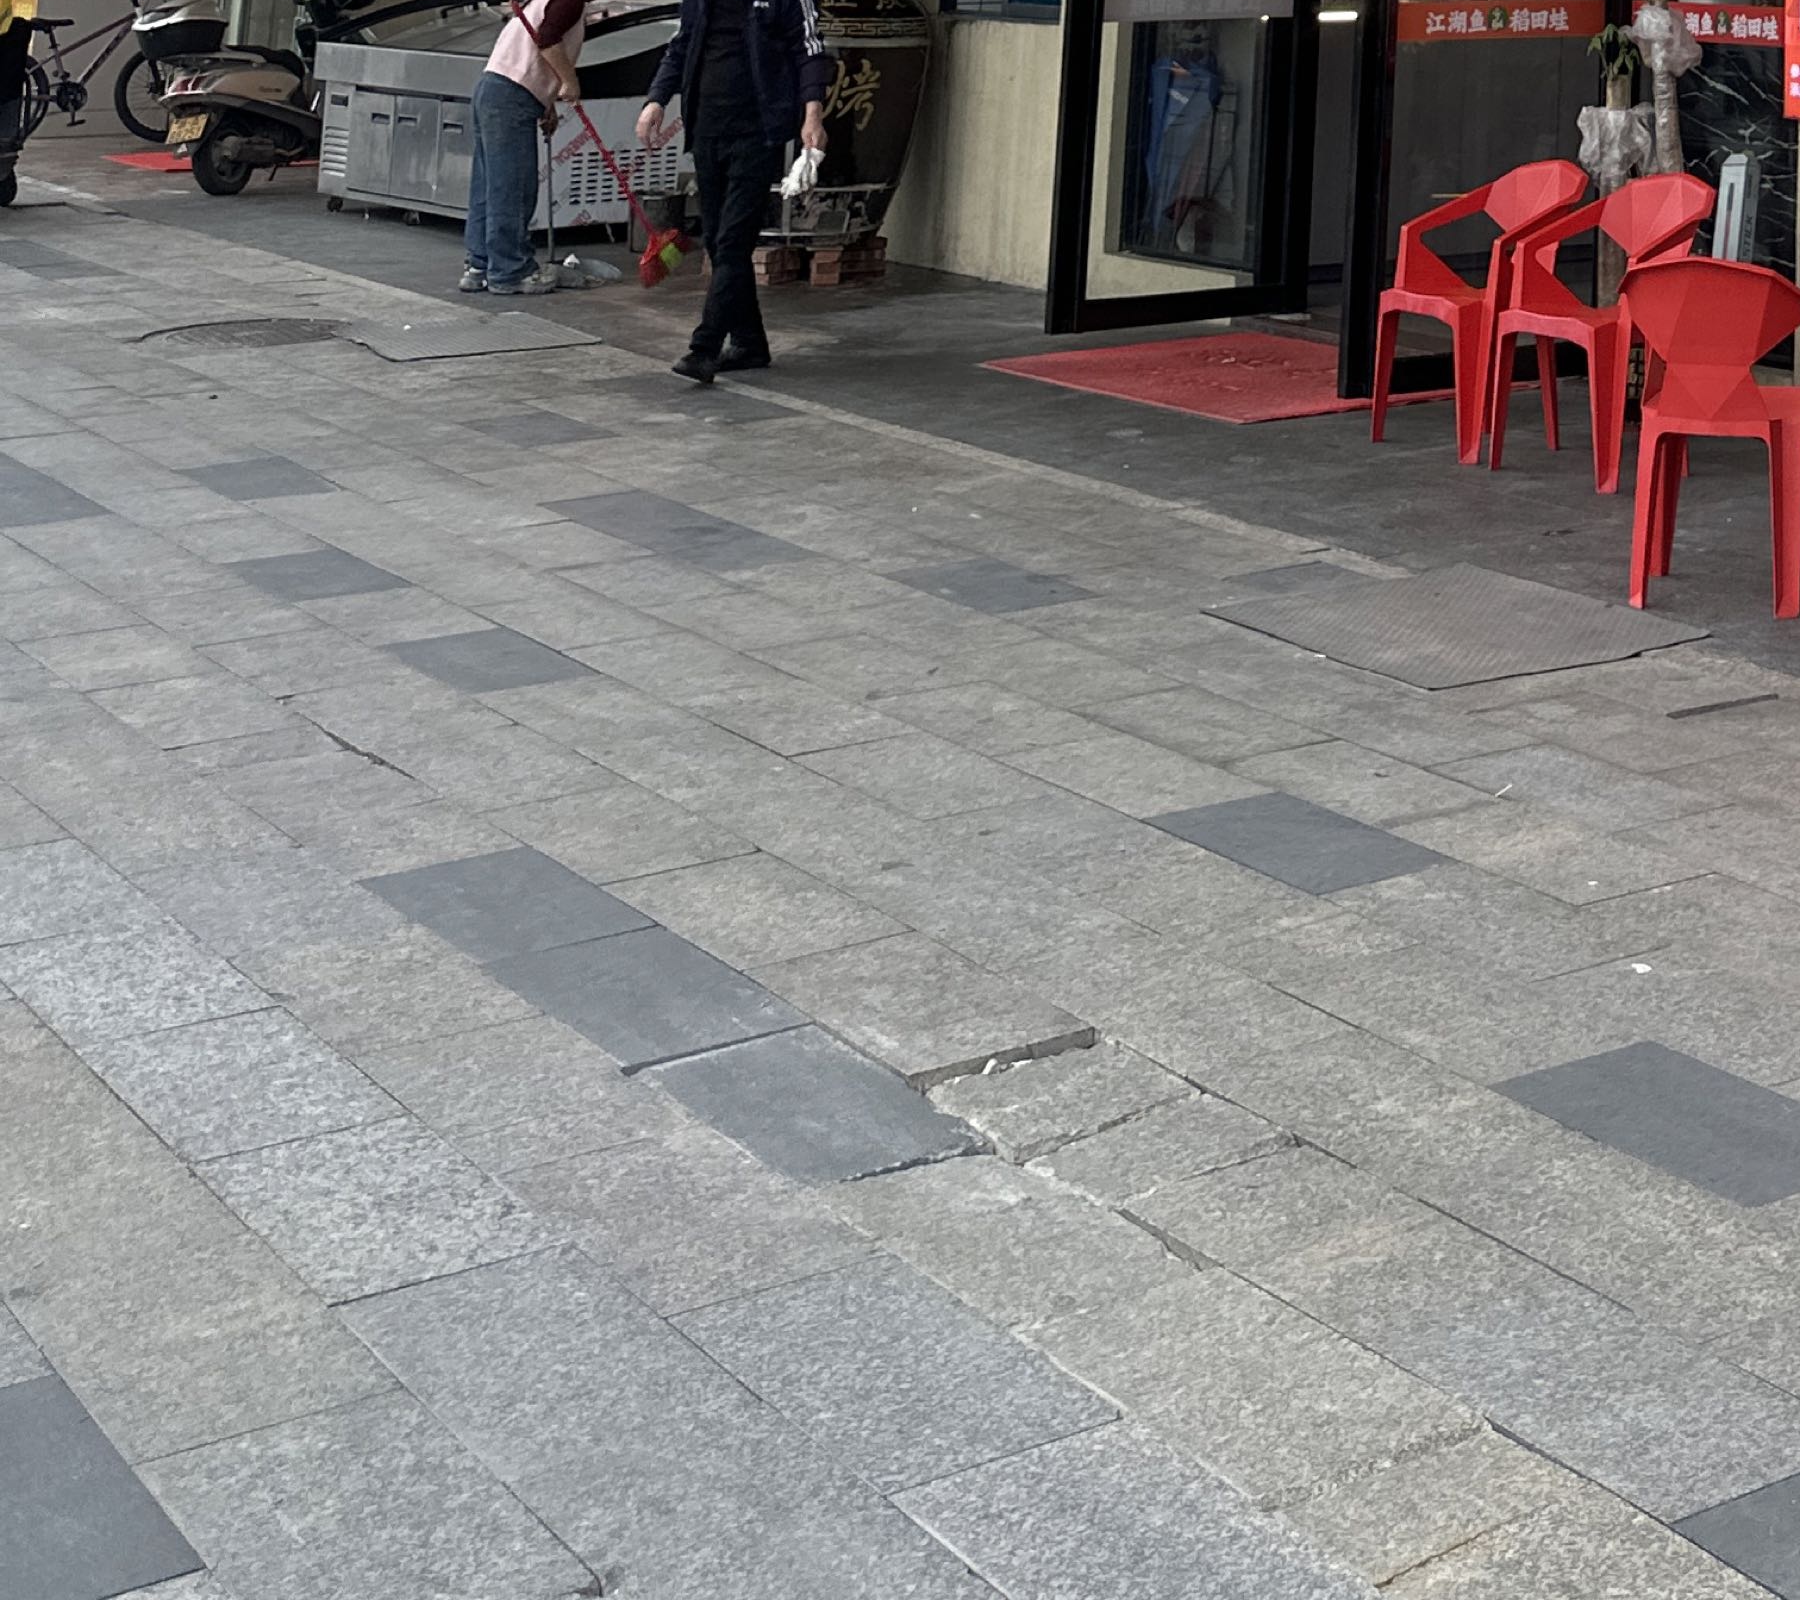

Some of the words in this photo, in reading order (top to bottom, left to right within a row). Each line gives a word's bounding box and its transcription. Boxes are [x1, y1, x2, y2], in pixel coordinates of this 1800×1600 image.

[1425, 9, 1487, 34] 江湖鱼
[1509, 7, 1569, 32] 稻田蛙
[1731, 15, 1779, 41] 稻田蛙
